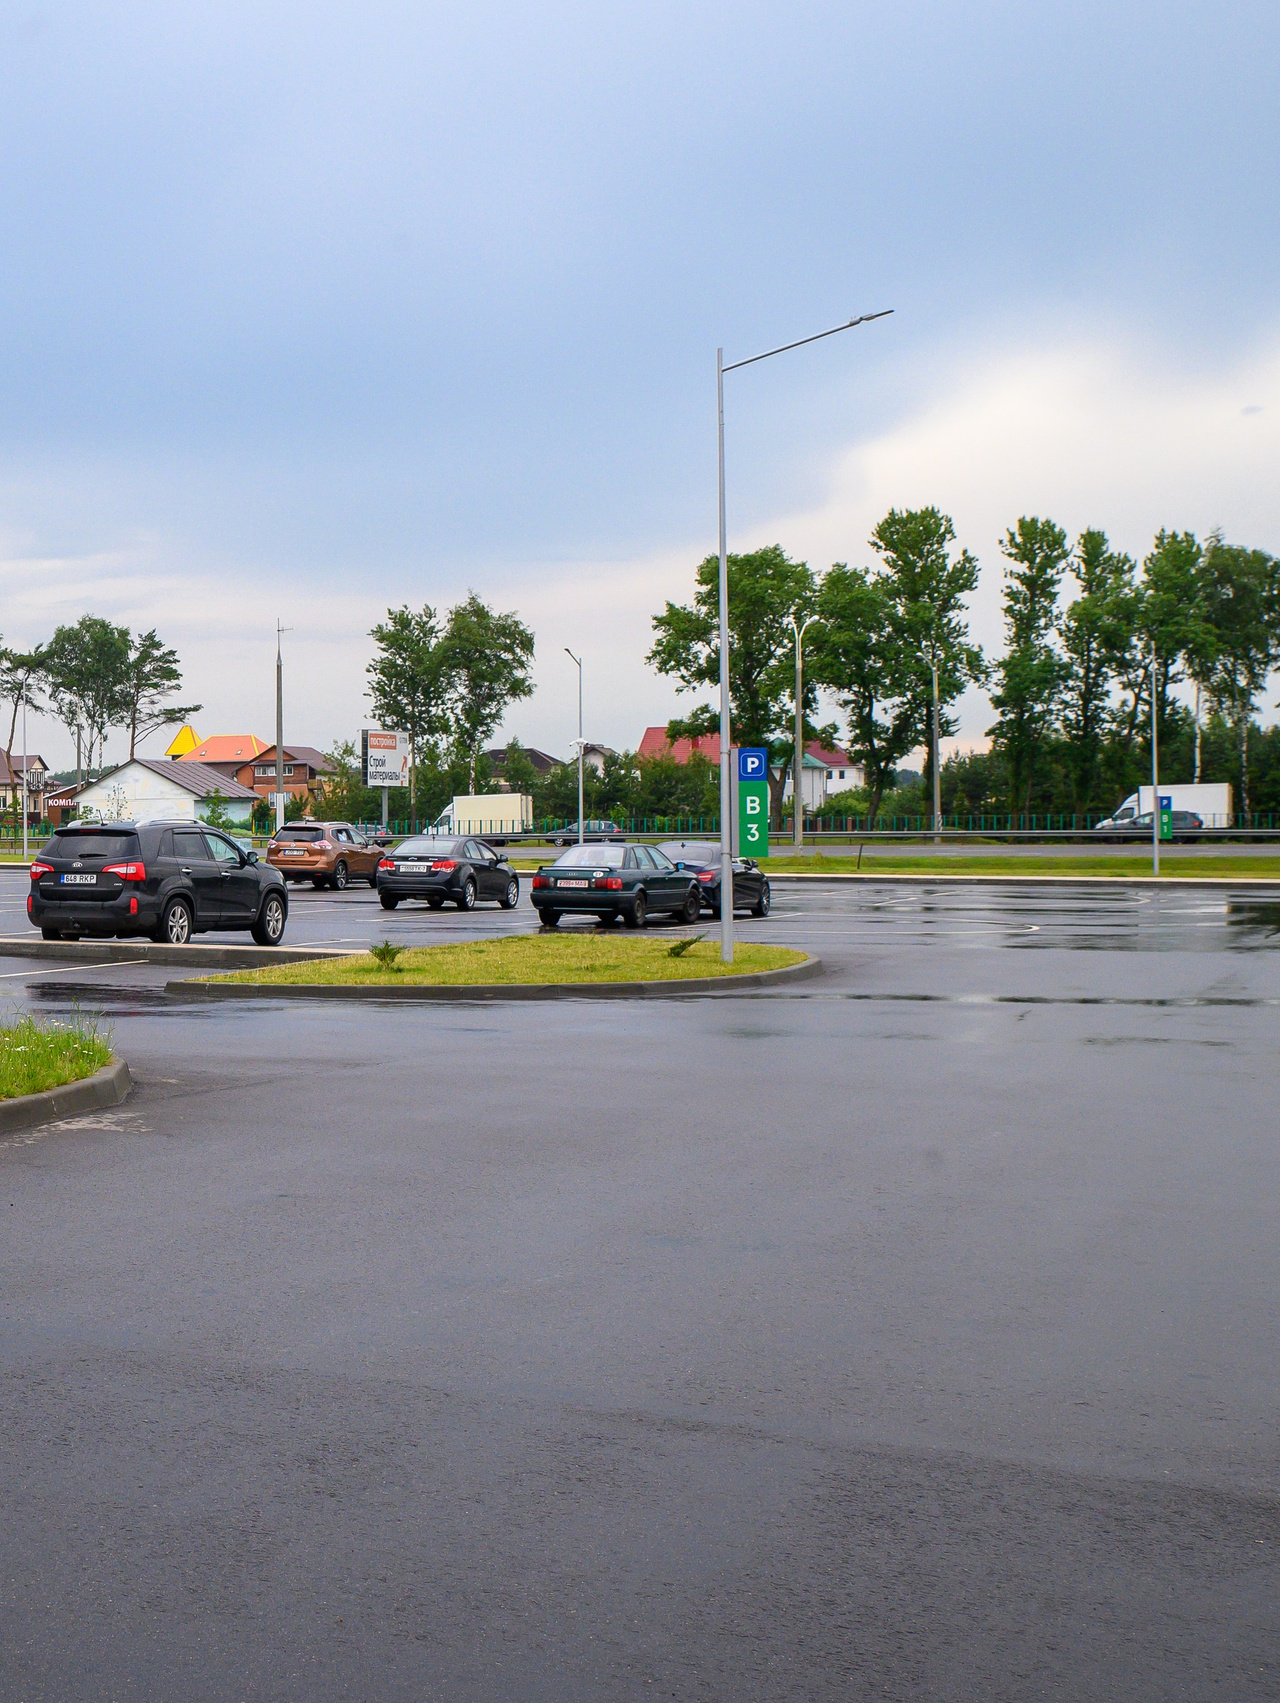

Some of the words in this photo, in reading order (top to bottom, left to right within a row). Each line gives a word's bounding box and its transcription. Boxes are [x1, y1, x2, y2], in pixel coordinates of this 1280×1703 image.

[369, 755, 386, 770] Строй
[747, 757, 759, 772] P
[369, 771, 401, 783] материалы
[746, 796, 760, 814] B
[746, 824, 759, 841] 3
[65, 874, 77, 883] 648
[80, 875, 95, 883] RKP
